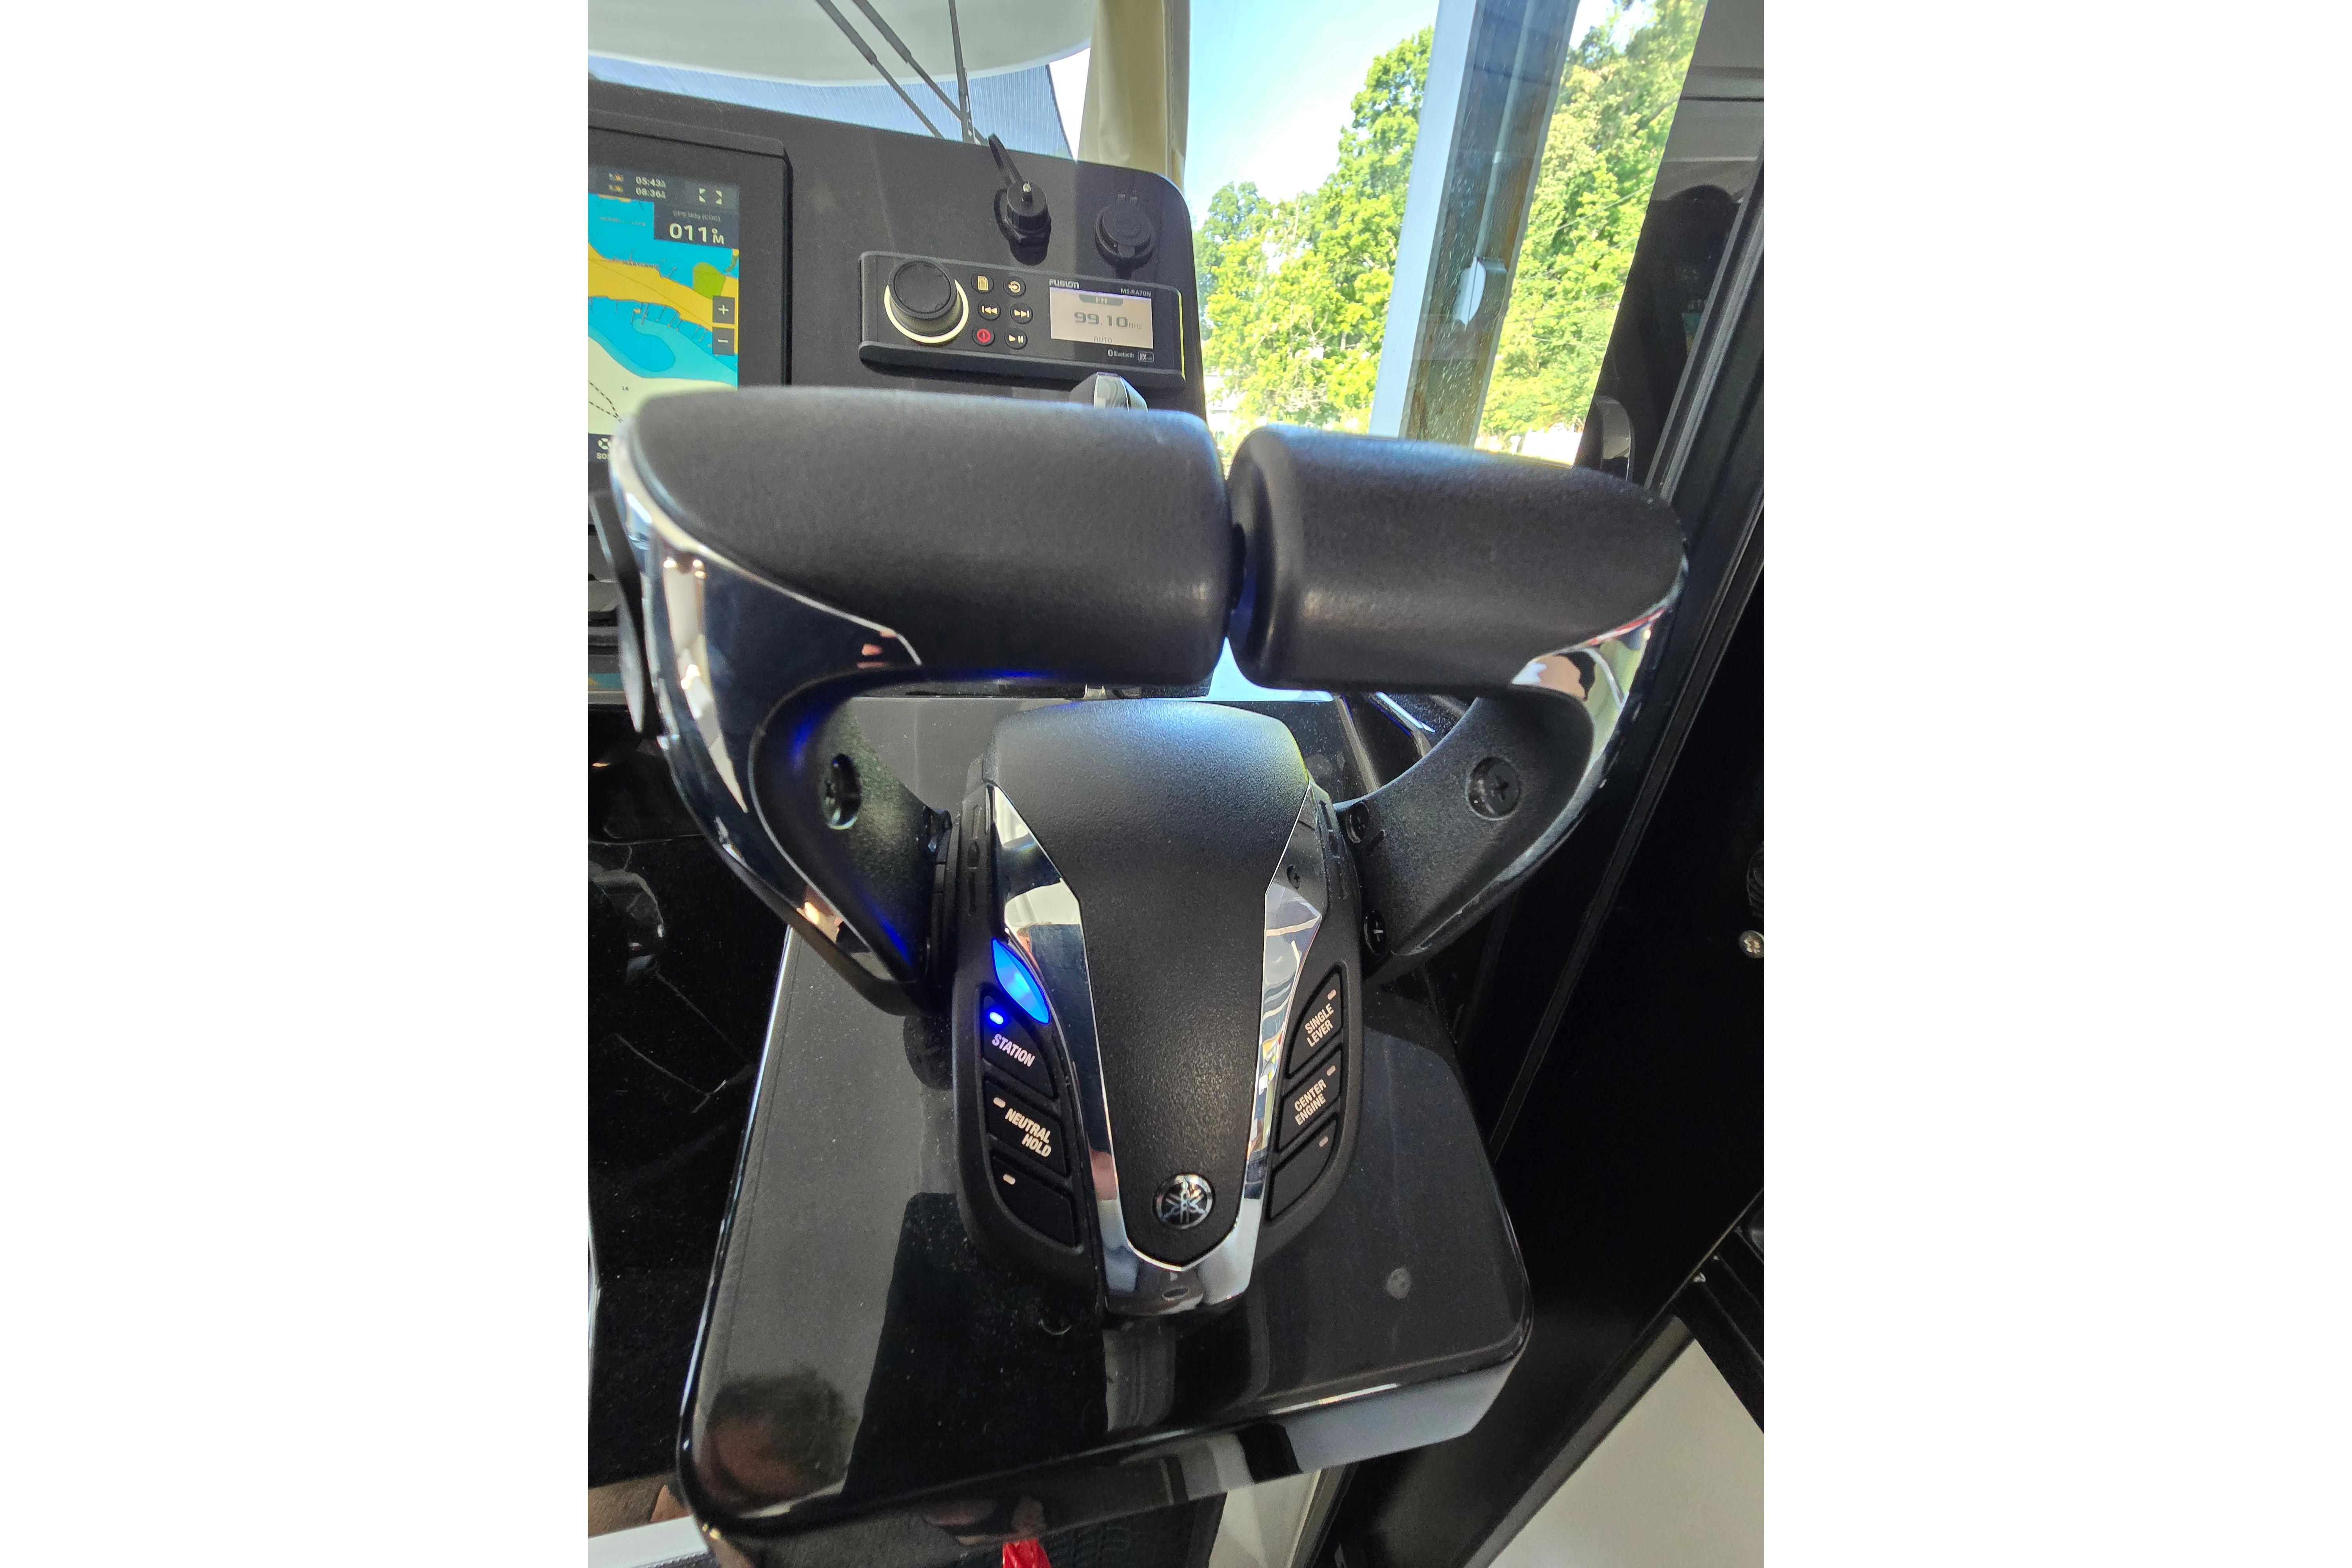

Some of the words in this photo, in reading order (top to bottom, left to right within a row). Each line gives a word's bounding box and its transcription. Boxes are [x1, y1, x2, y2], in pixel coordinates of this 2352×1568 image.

[1305, 1003, 1334, 1034] SINGLE
[1307, 1019, 1333, 1047] LEVER
[991, 1033, 1035, 1067] STATION
[1294, 1079, 1327, 1112] CENTER
[1295, 1093, 1326, 1126] ENGINE
[1005, 1108, 1051, 1144] NEUTRAL
[1022, 1133, 1052, 1157] HOLD
